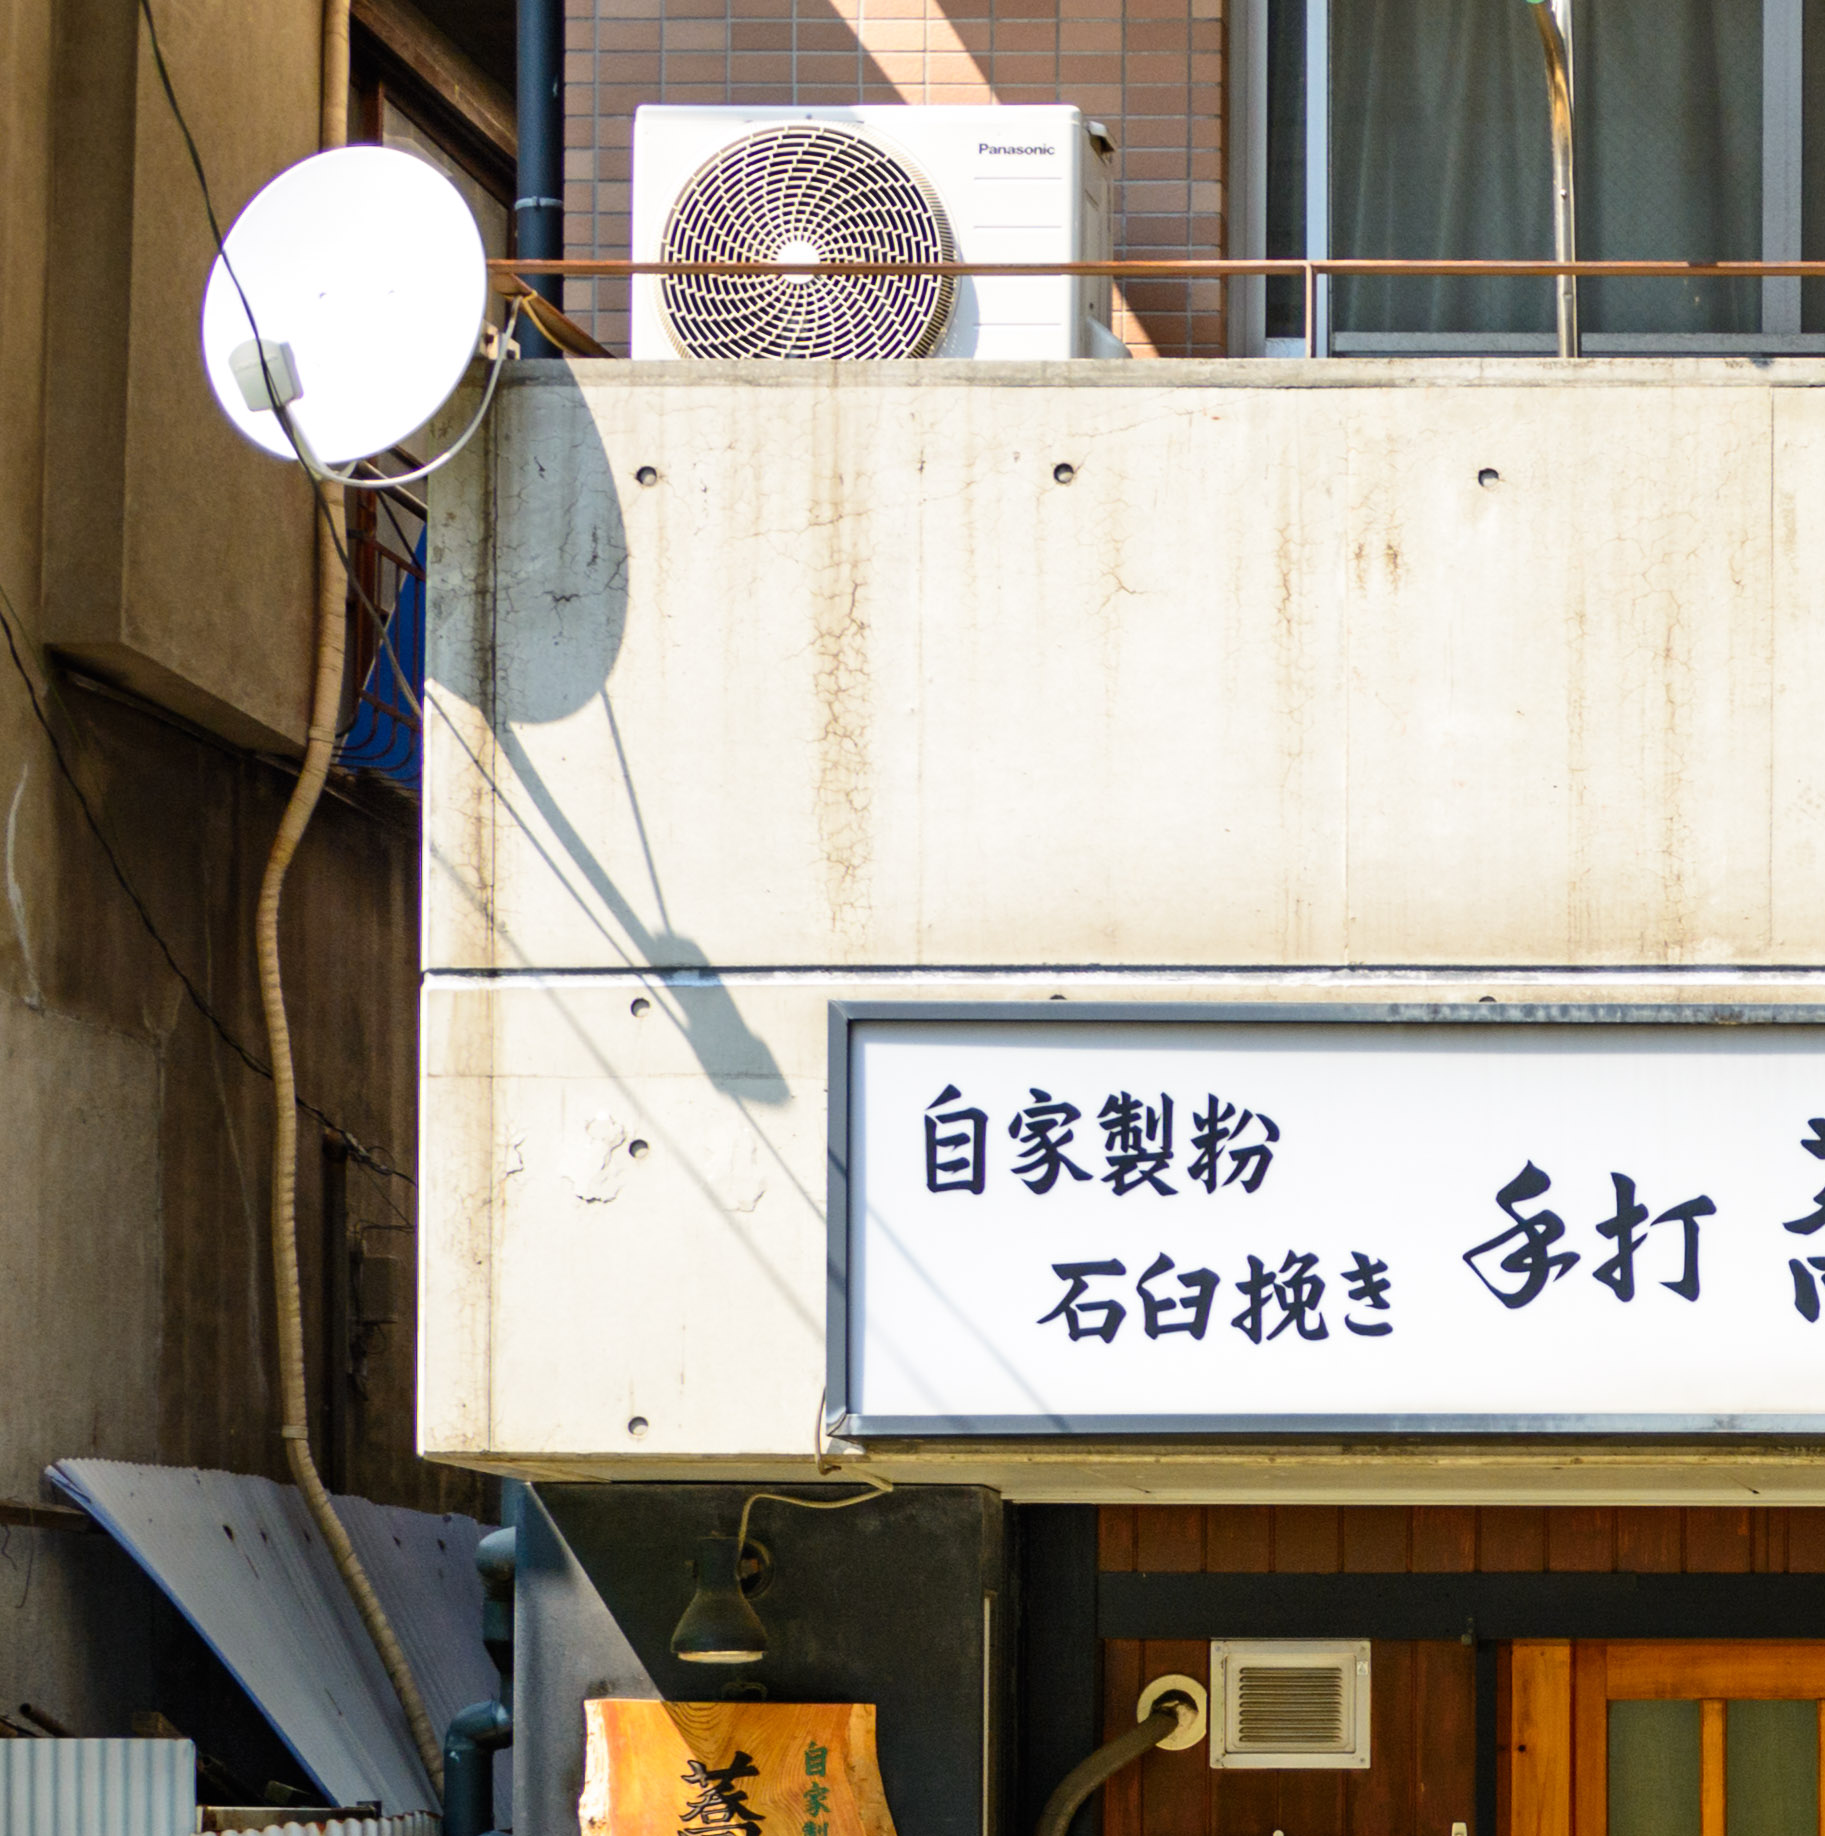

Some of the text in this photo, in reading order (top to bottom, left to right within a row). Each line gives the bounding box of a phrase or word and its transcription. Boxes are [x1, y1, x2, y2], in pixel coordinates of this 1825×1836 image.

[978, 143, 1055, 155] Panasonic
[924, 1081, 1281, 1196] 自家製粉
[1468, 1161, 1717, 1310] 手打
[1037, 1248, 1394, 1346] 石臼挽き
